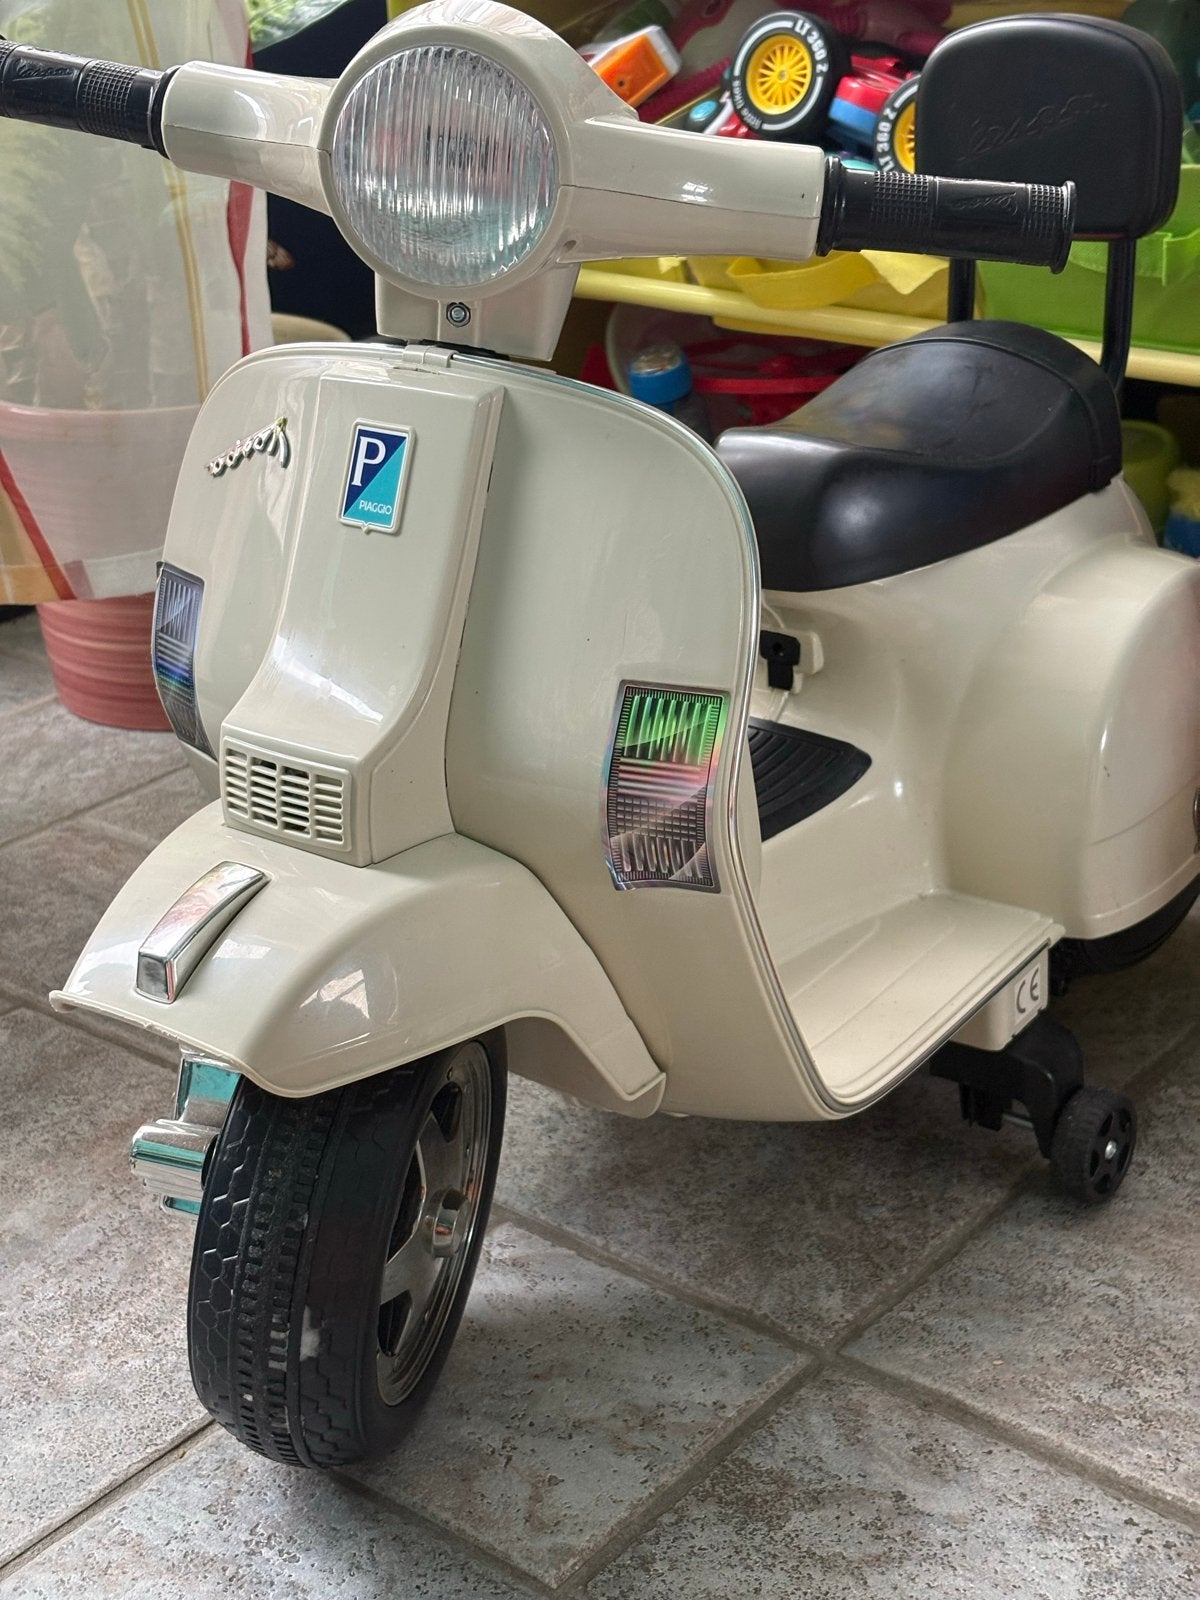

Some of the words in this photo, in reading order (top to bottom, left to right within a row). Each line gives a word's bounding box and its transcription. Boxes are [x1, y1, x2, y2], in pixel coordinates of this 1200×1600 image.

[794, 19, 811, 36] LT
[351, 435, 386, 487] P
[358, 499, 393, 516] PIAGGIO
[1016, 966, 1039, 1014] CE
